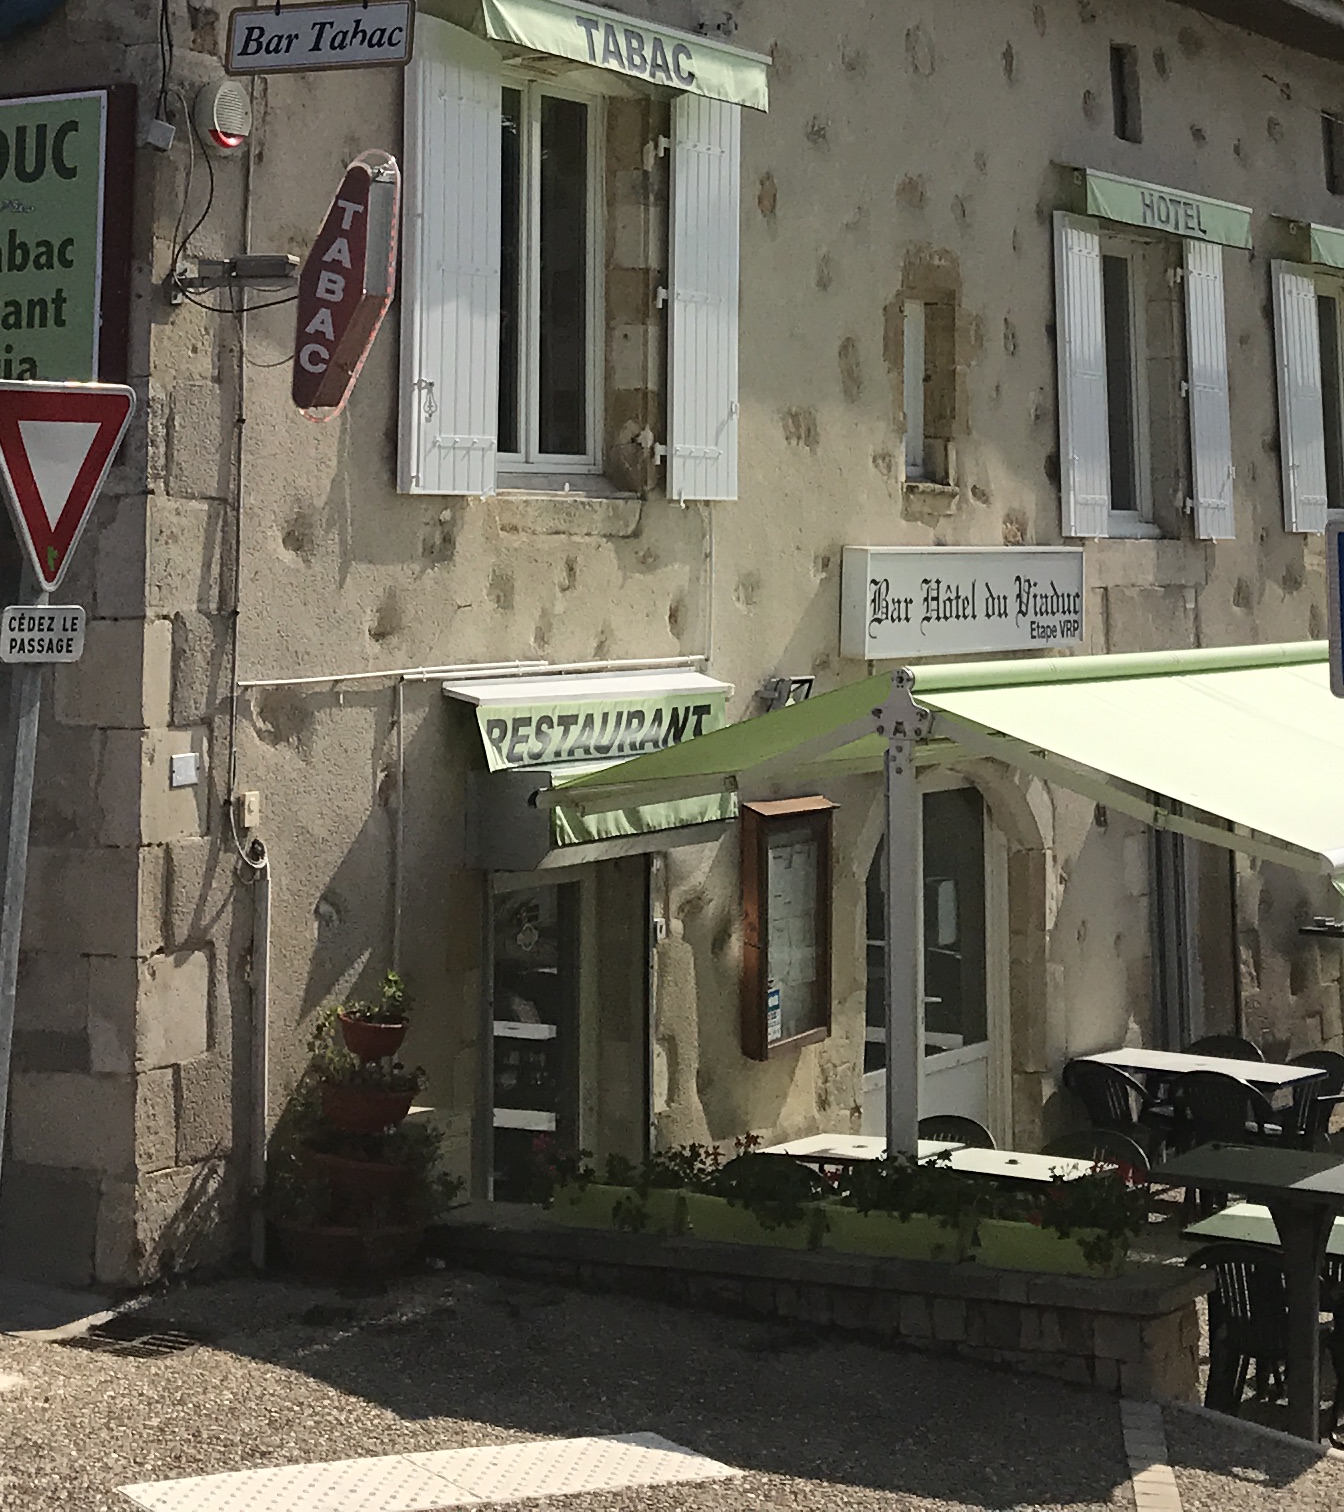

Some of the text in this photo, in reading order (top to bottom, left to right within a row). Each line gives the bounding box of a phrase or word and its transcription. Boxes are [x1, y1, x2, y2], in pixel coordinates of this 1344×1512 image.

[237, 18, 404, 57] Bar Tabac
[572, 14, 696, 87] TABAC
[1140, 191, 1207, 236] HOTEL
[299, 199, 365, 374] TABAC
[8, 612, 79, 633] CÉDEZ LE
[868, 574, 1081, 639] Bar Hôtel du Viaduc
[9, 637, 74, 654] PASSAGE
[1030, 619, 1079, 643] Etape VRP
[485, 703, 711, 763] RESTAURANT
